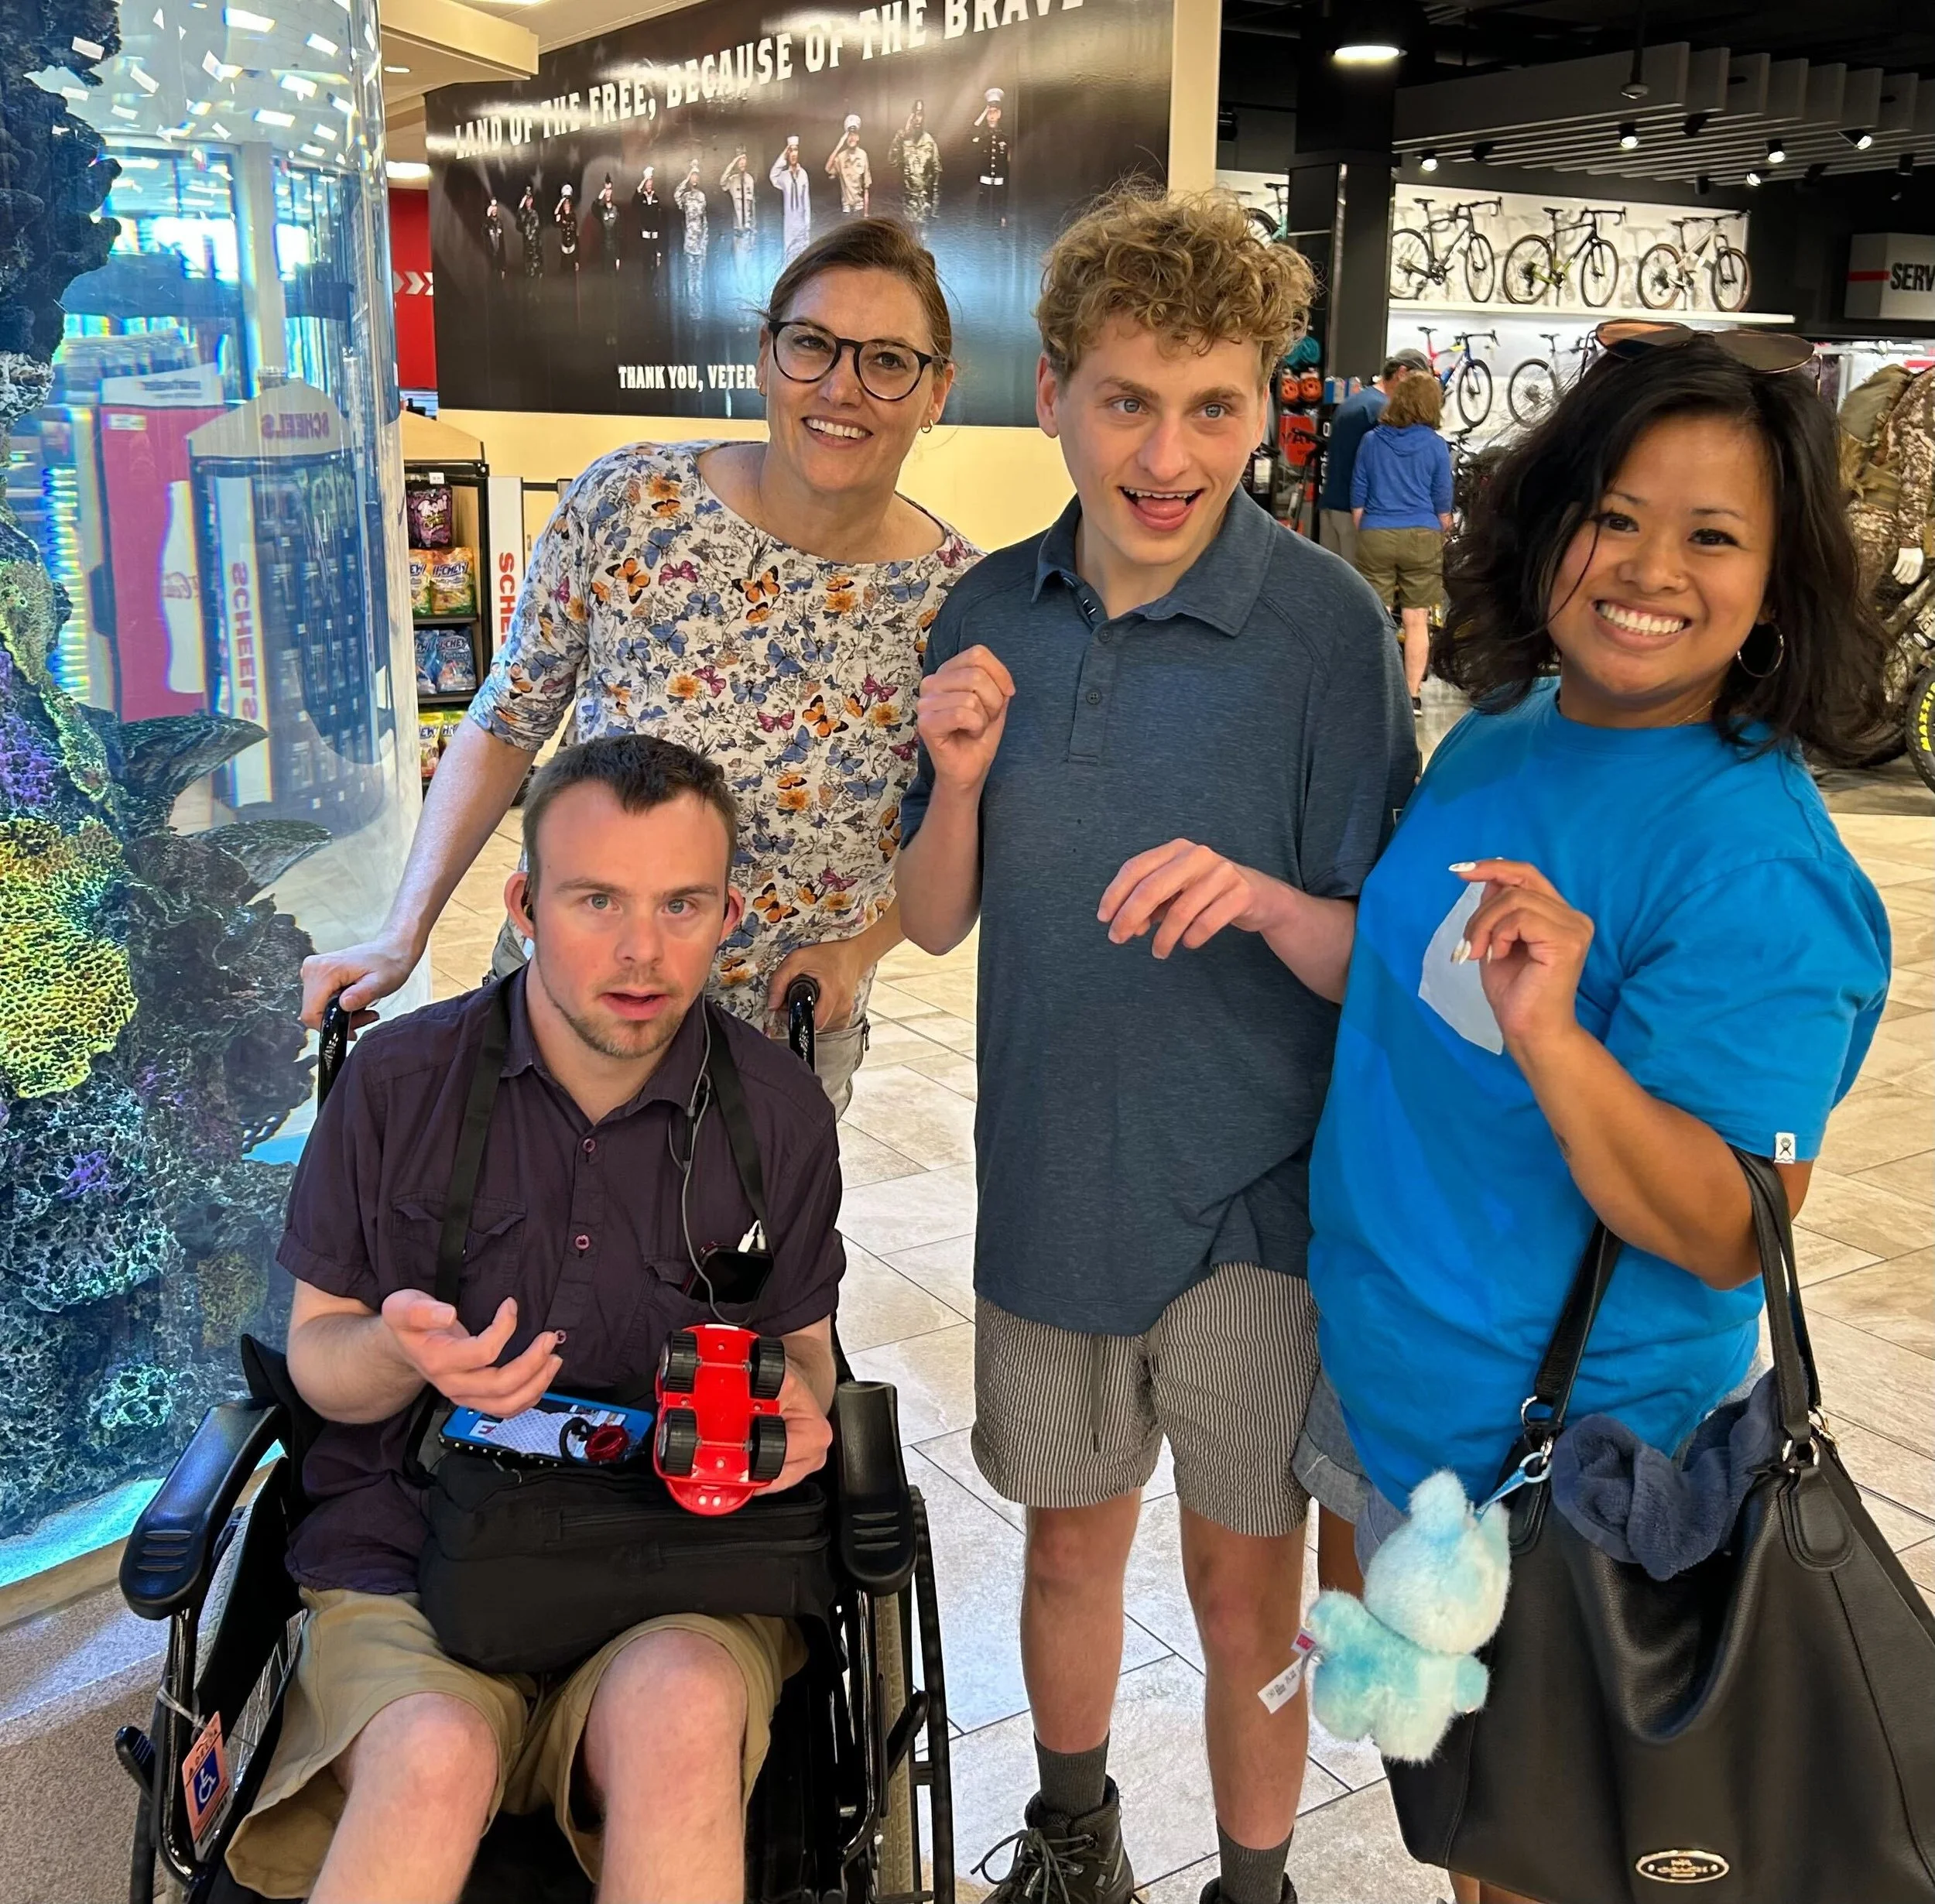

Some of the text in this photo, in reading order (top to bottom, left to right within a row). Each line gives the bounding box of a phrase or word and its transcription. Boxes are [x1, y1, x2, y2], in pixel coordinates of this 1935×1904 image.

[455, 115, 502, 159] LAND
[509, 105, 533, 146] OF
[541, 92, 580, 139] THE
[588, 78, 656, 121] FREE,
[666, 33, 793, 108] BECAUSE
[805, 21, 843, 73] OF
[859, 0, 928, 60] THE
[618, 365, 760, 392] THANK YOU, VETER
[499, 553, 515, 646] SCHE
